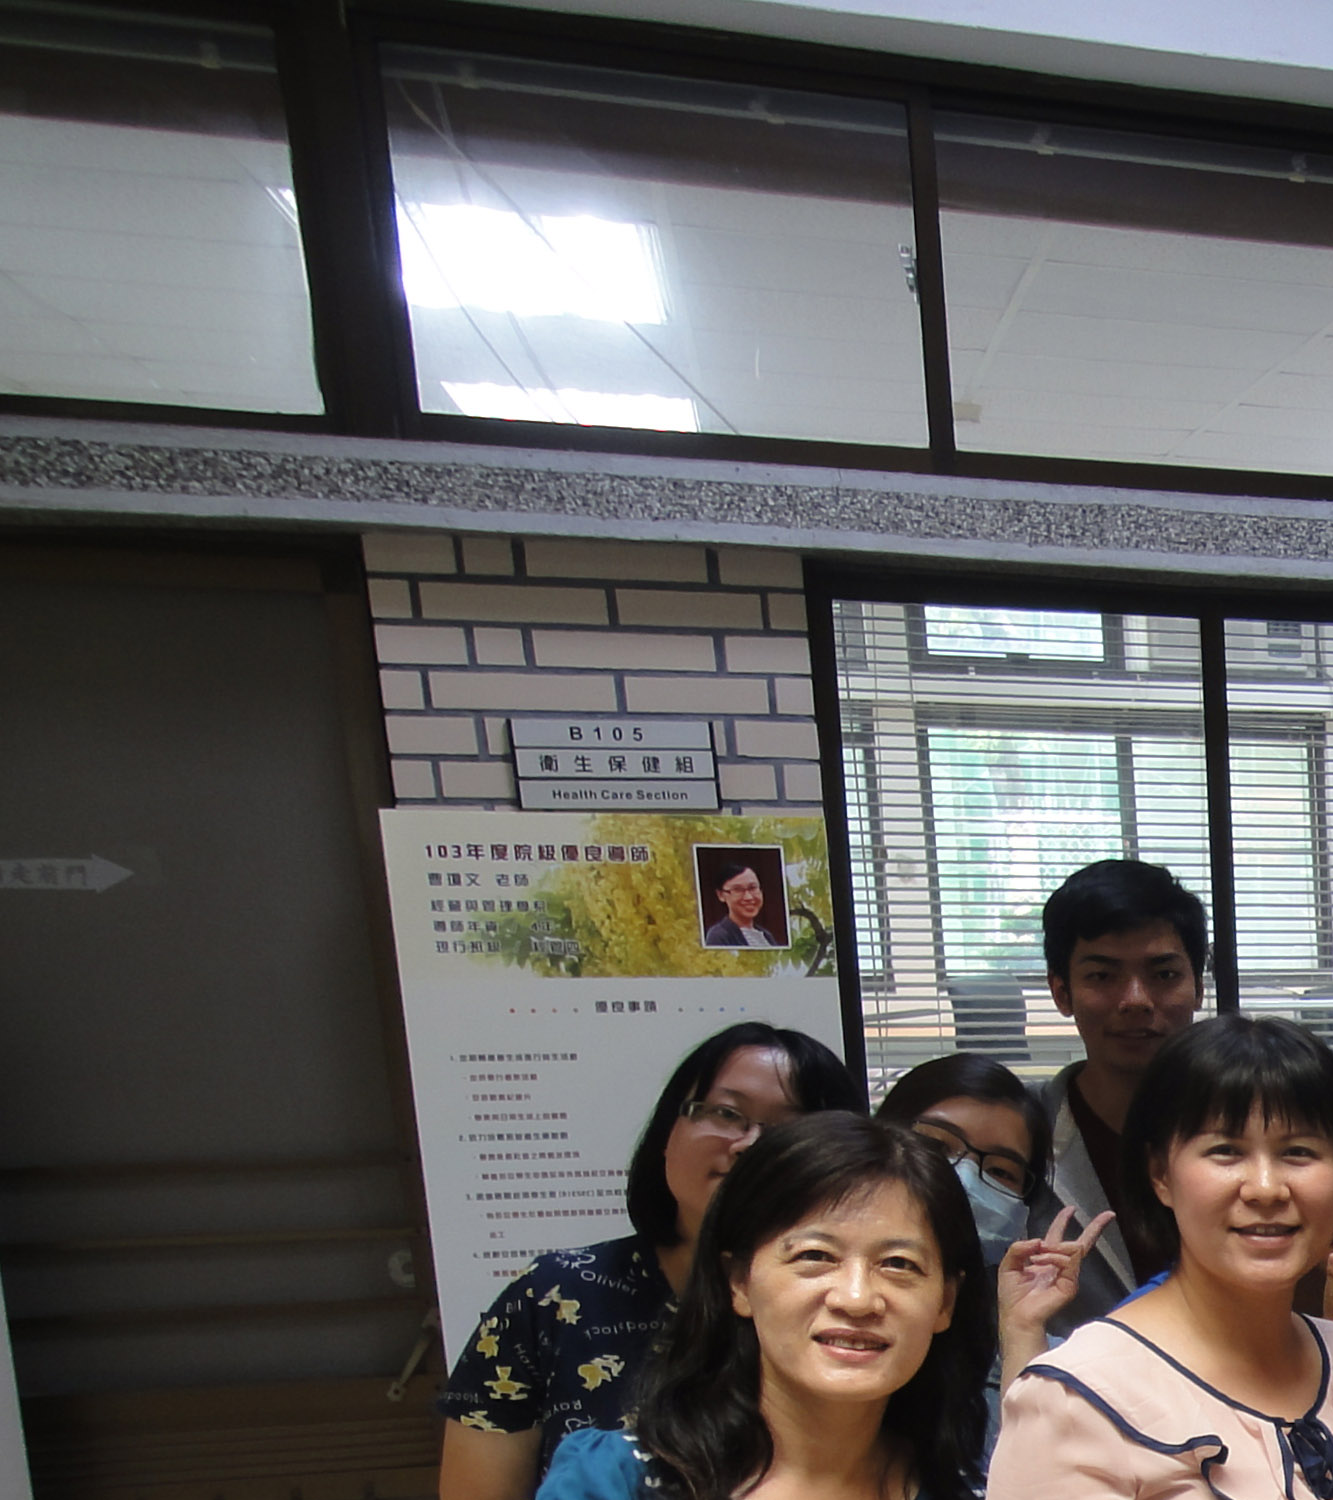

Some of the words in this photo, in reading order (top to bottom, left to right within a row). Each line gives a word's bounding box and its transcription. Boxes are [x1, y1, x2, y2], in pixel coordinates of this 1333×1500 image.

[539, 754, 695, 775] 衛生保健組
[552, 787, 598, 801] Health
[600, 788, 633, 801] Care
[635, 788, 688, 802] Section
[425, 843, 650, 862] 103年度院級優良導師
[495, 873, 529, 887] 老師
[580, 1270, 639, 1297] Olivier
